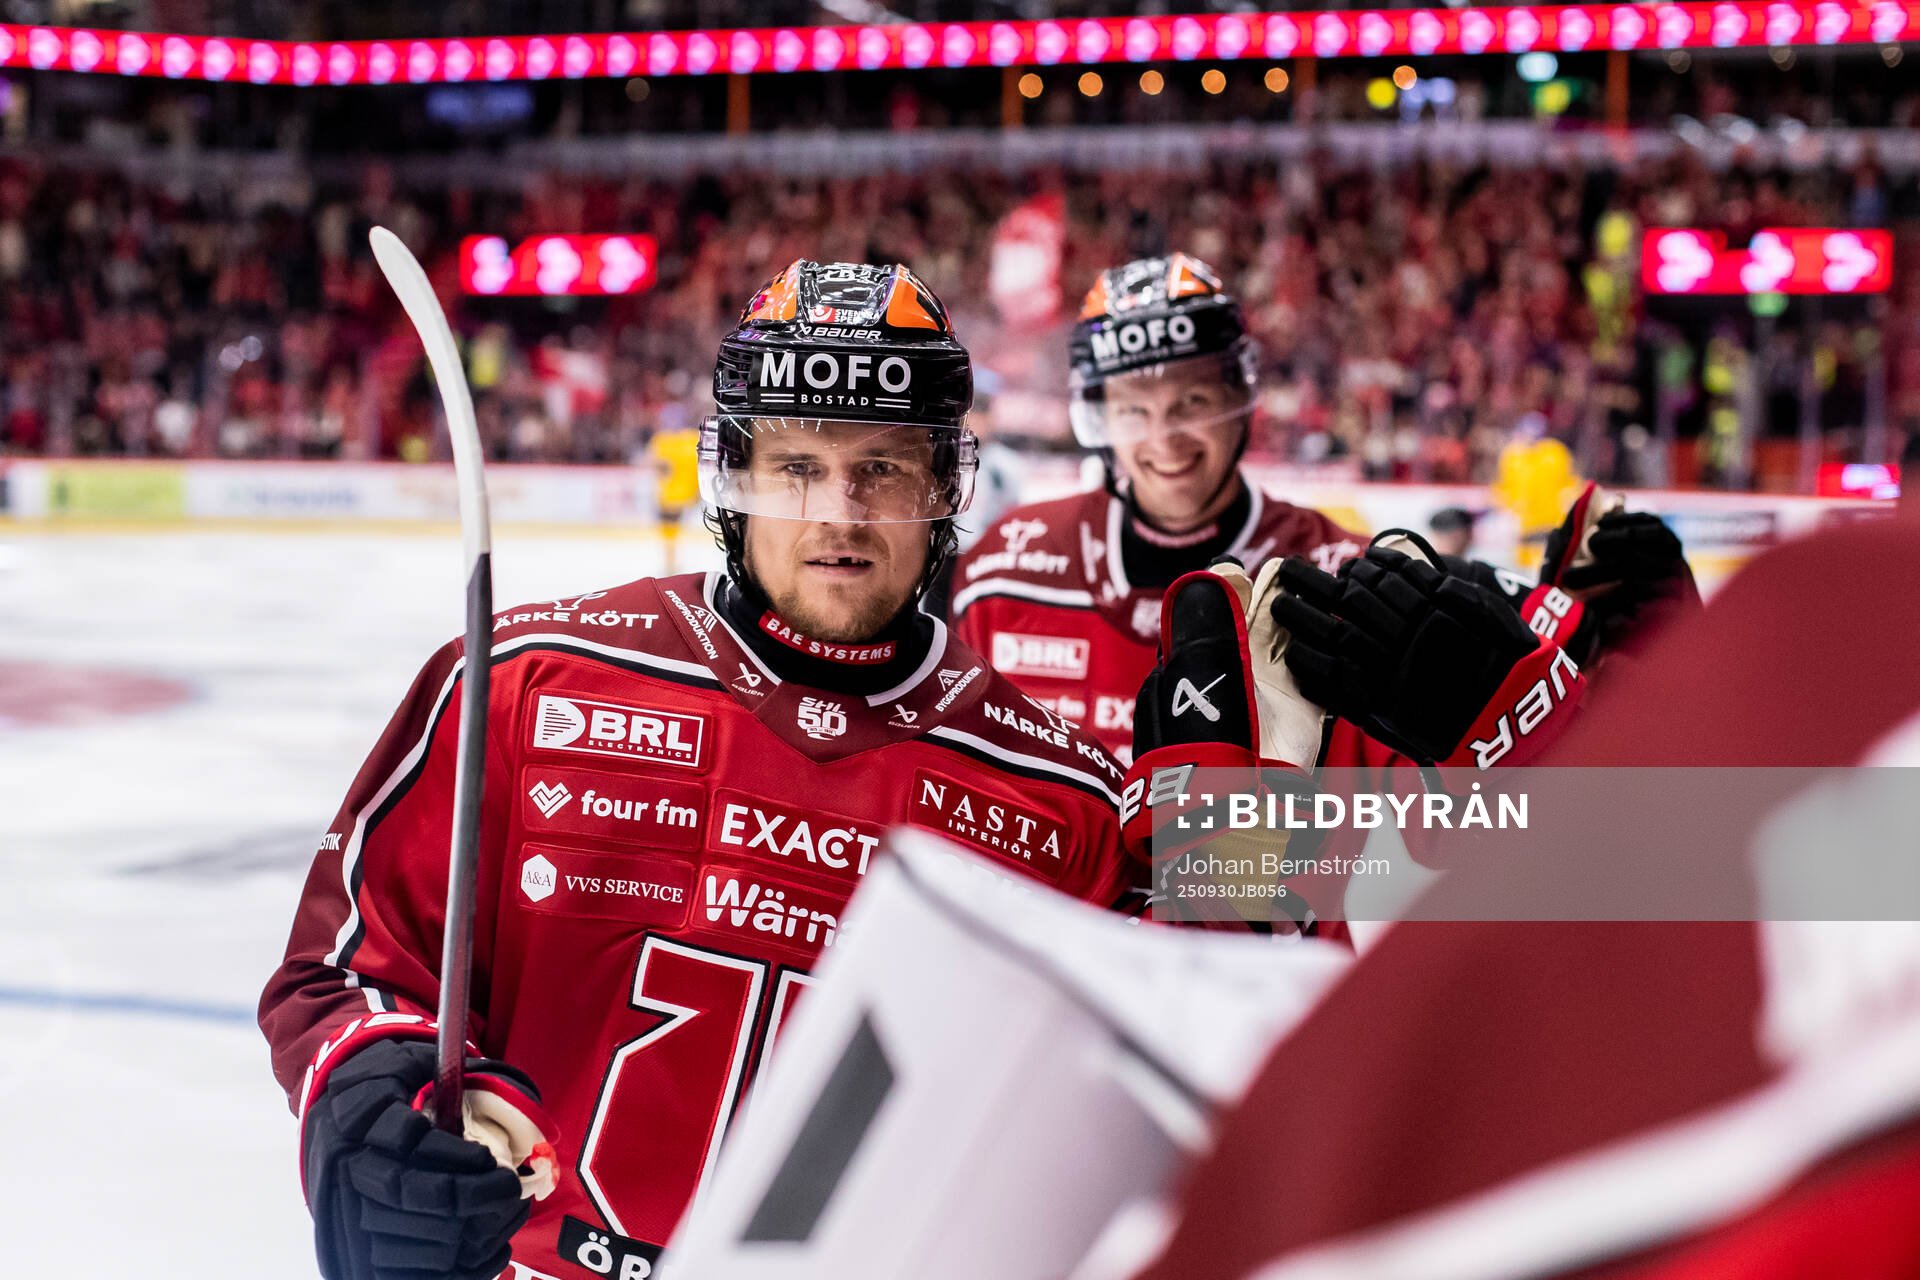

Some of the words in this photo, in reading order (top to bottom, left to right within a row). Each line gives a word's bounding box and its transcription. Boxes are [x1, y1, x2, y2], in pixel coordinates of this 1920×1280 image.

[1091, 315, 1195, 360] MOFO
[760, 352, 911, 393] MOFO
[801, 394, 869, 407] BOSTAD
[493, 611, 570, 632] ÄRKE
[580, 610, 659, 629] KÖTT
[665, 590, 719, 660] BYGGPRODUKTION
[766, 618, 804, 645] BAE
[809, 641, 892, 660] SYSTEMS
[934, 666, 982, 713] BYGGPRODUKTION
[588, 709, 694, 752] BRL
[797, 705, 847, 736] 50
[984, 701, 1070, 749] NÄRKE
[588, 740, 692, 759] ELECTRONICS
[581, 790, 649, 822] four
[655, 798, 698, 828] fm
[919, 780, 1062, 860] NASTA
[319, 832, 343, 850] STIK
[720, 802, 880, 876] EXACT
[948, 819, 1032, 861] INTERIÖR
[524, 870, 551, 887] A&A
[565, 875, 600, 893] VVS
[604, 878, 684, 904] SERVICE
[706, 875, 846, 948] Wärn
[577, 1231, 652, 1280] ÖR
